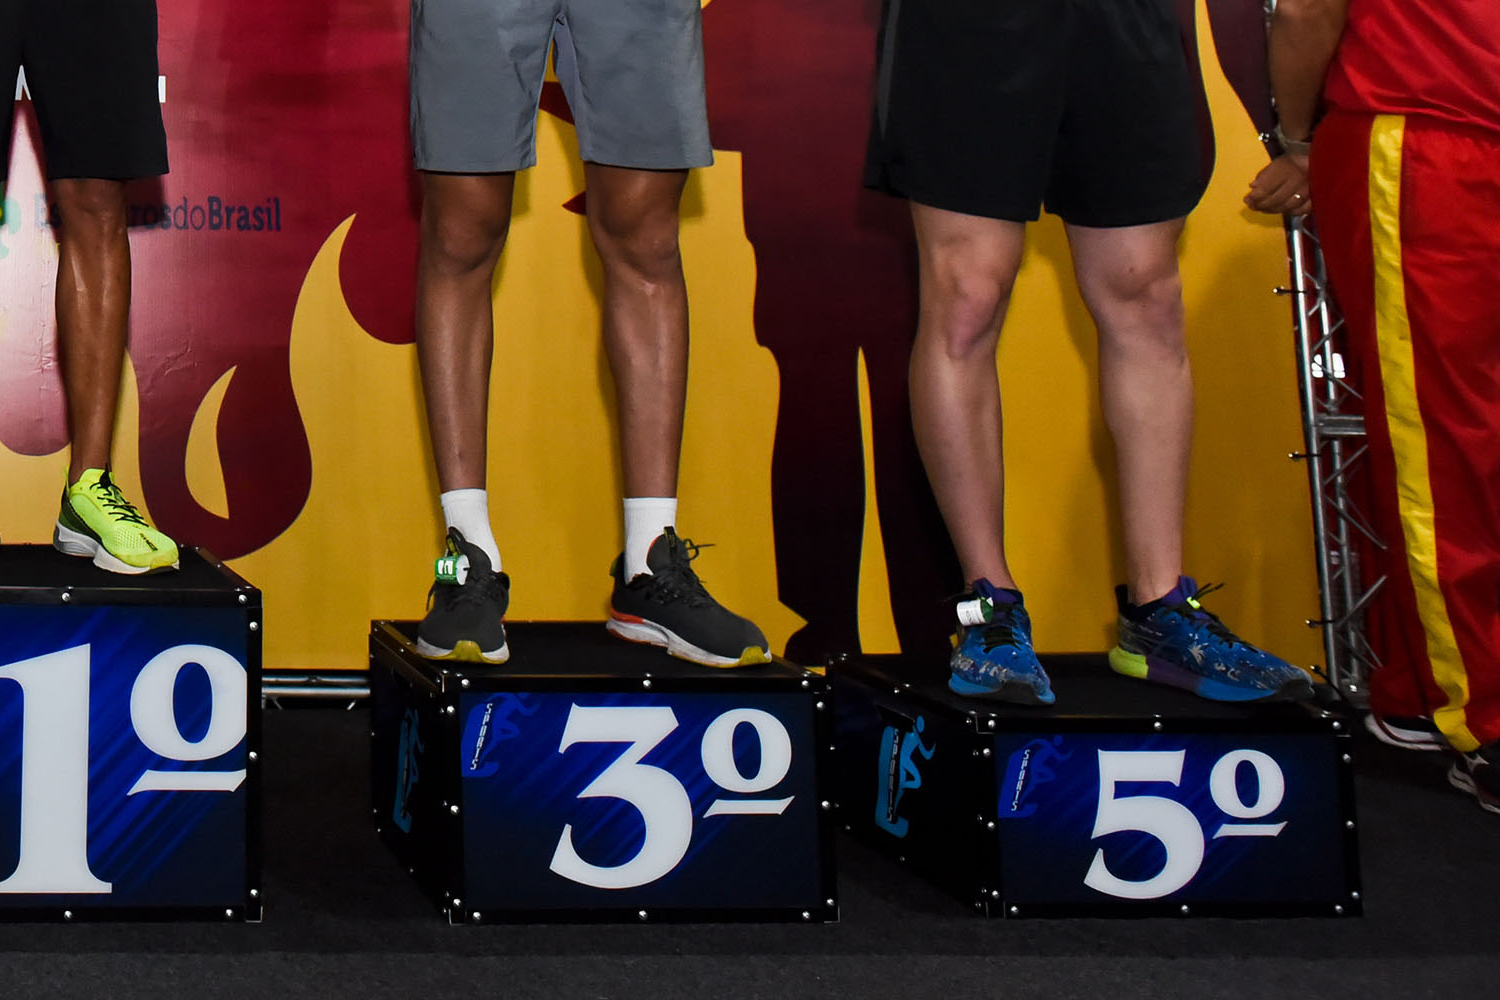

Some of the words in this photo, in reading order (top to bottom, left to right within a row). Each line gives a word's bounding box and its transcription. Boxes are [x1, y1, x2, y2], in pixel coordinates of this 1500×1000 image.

[469, 703, 493, 771] SPORTS
[1010, 749, 1032, 813] SPORTS
[549, 702, 796, 889] 3º
[1083, 748, 1288, 899] 5º
